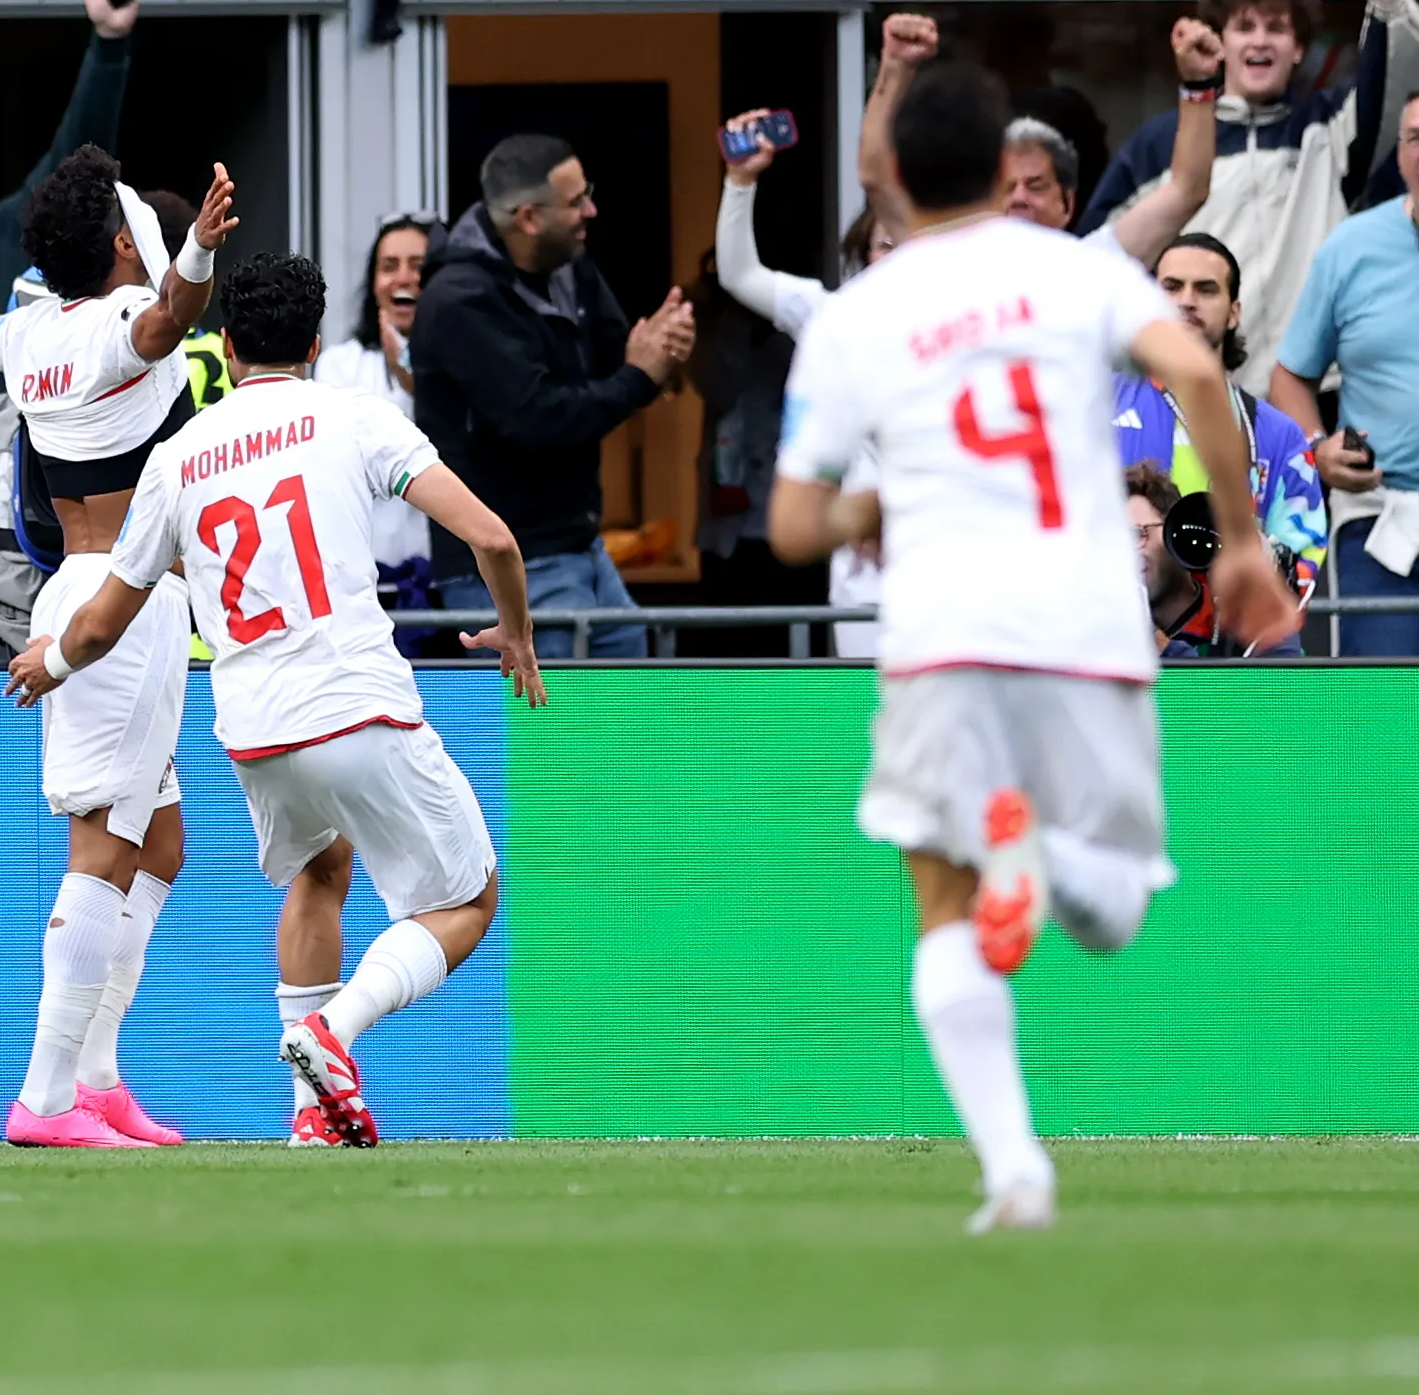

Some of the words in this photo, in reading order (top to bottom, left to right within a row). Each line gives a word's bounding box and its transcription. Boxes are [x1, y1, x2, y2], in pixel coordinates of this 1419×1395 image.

[180, 414, 316, 488] MOHAMMAD
[952, 358, 1064, 529] 4
[196, 473, 333, 645] 21
